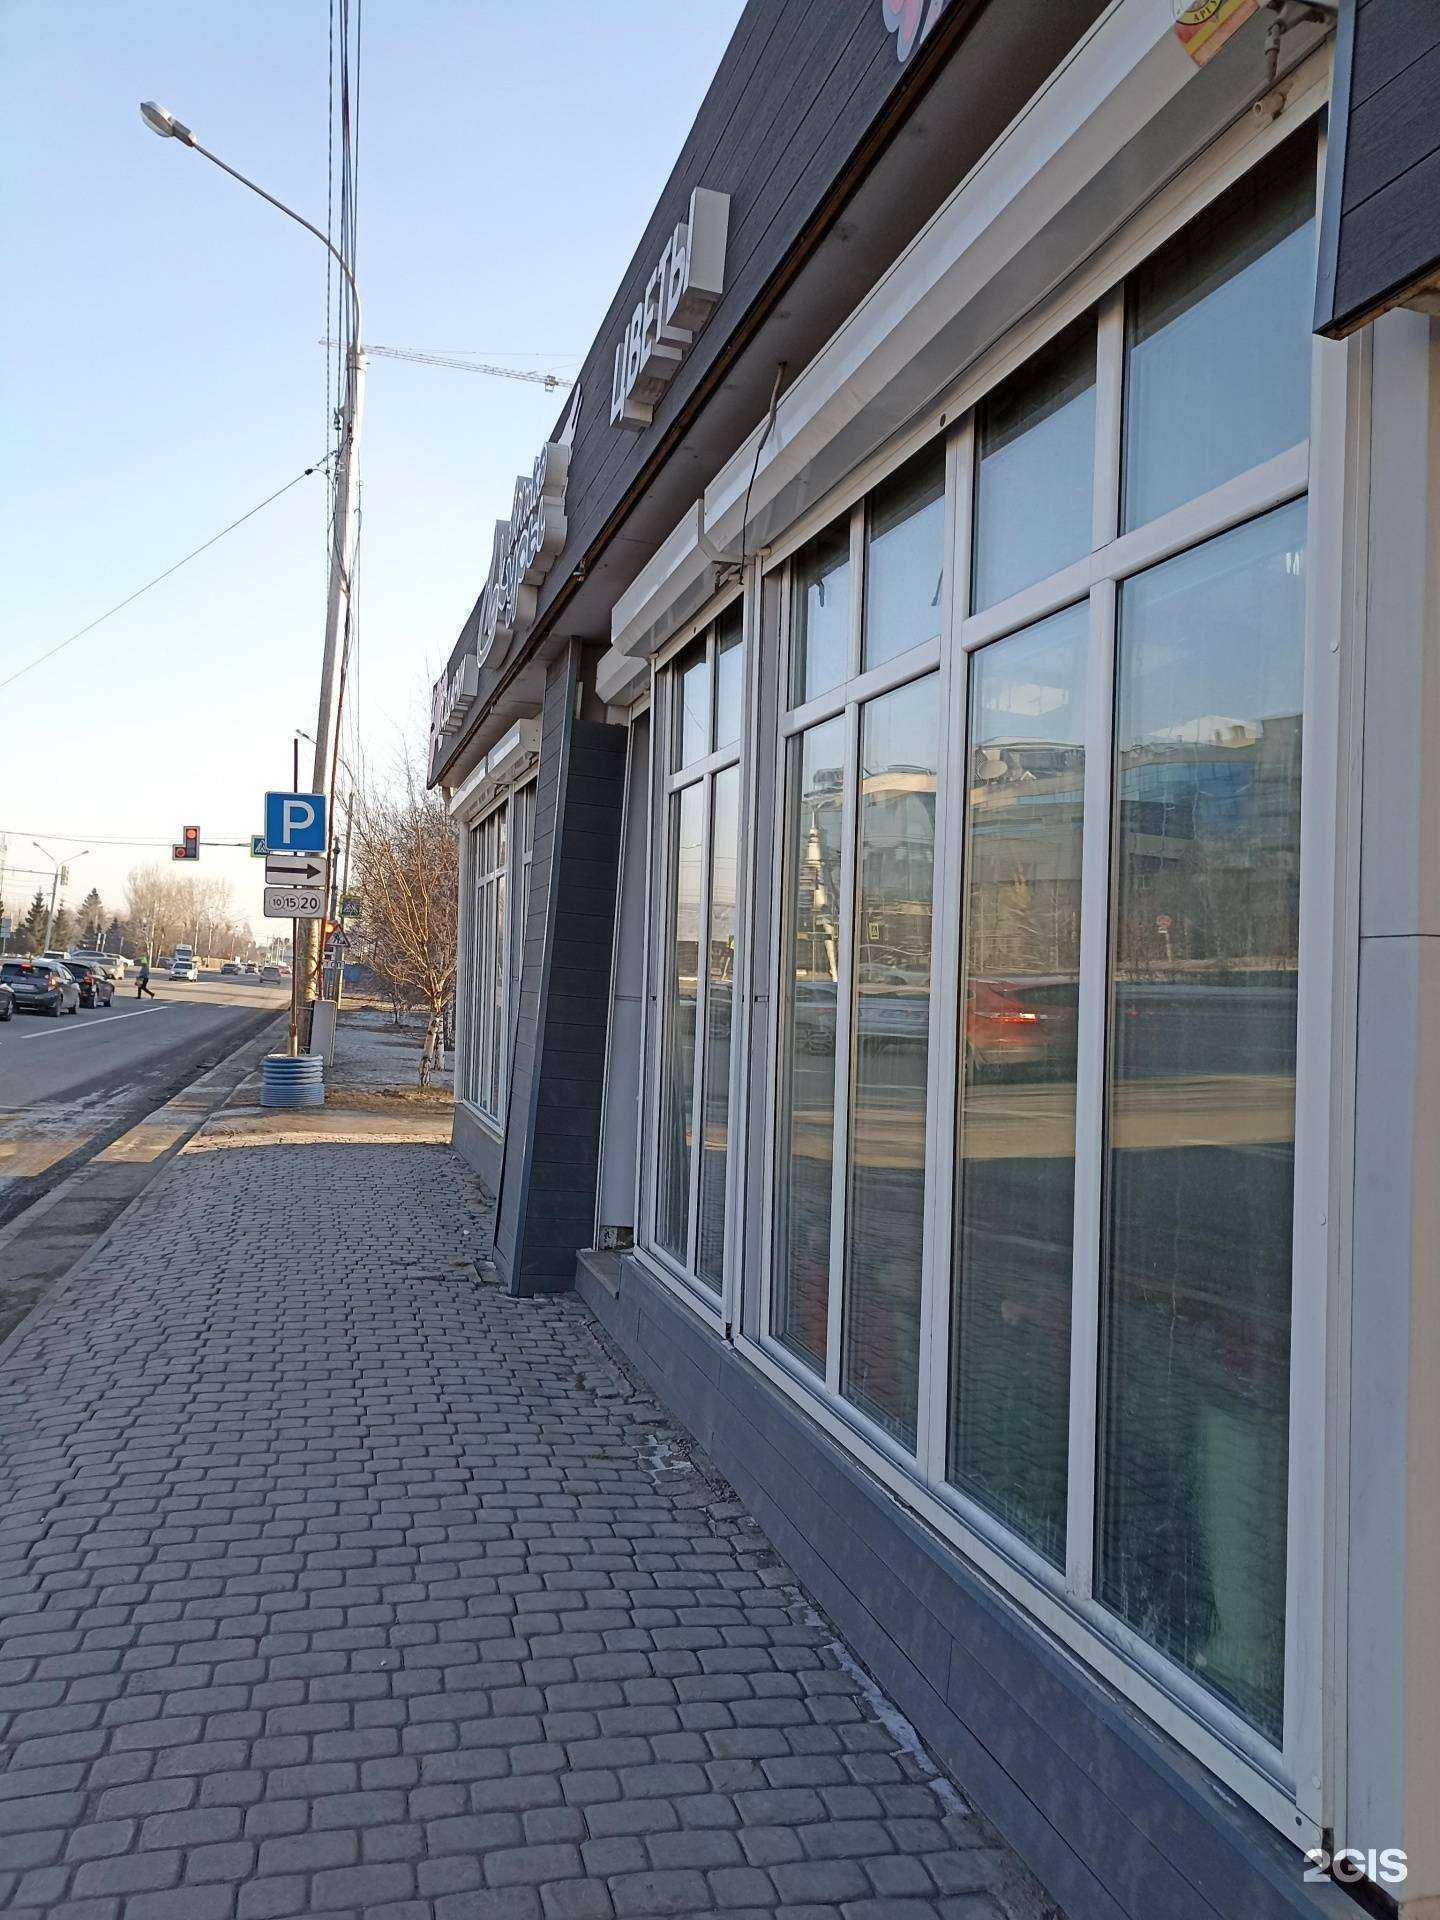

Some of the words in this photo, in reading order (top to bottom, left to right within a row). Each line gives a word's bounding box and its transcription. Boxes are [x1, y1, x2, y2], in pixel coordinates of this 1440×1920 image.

[609, 187, 728, 430] ЦВЕТЫ
[283, 799, 315, 844] P
[272, 898, 282, 907] 10
[285, 897, 296, 908] 15
[300, 897, 318, 909] 20
